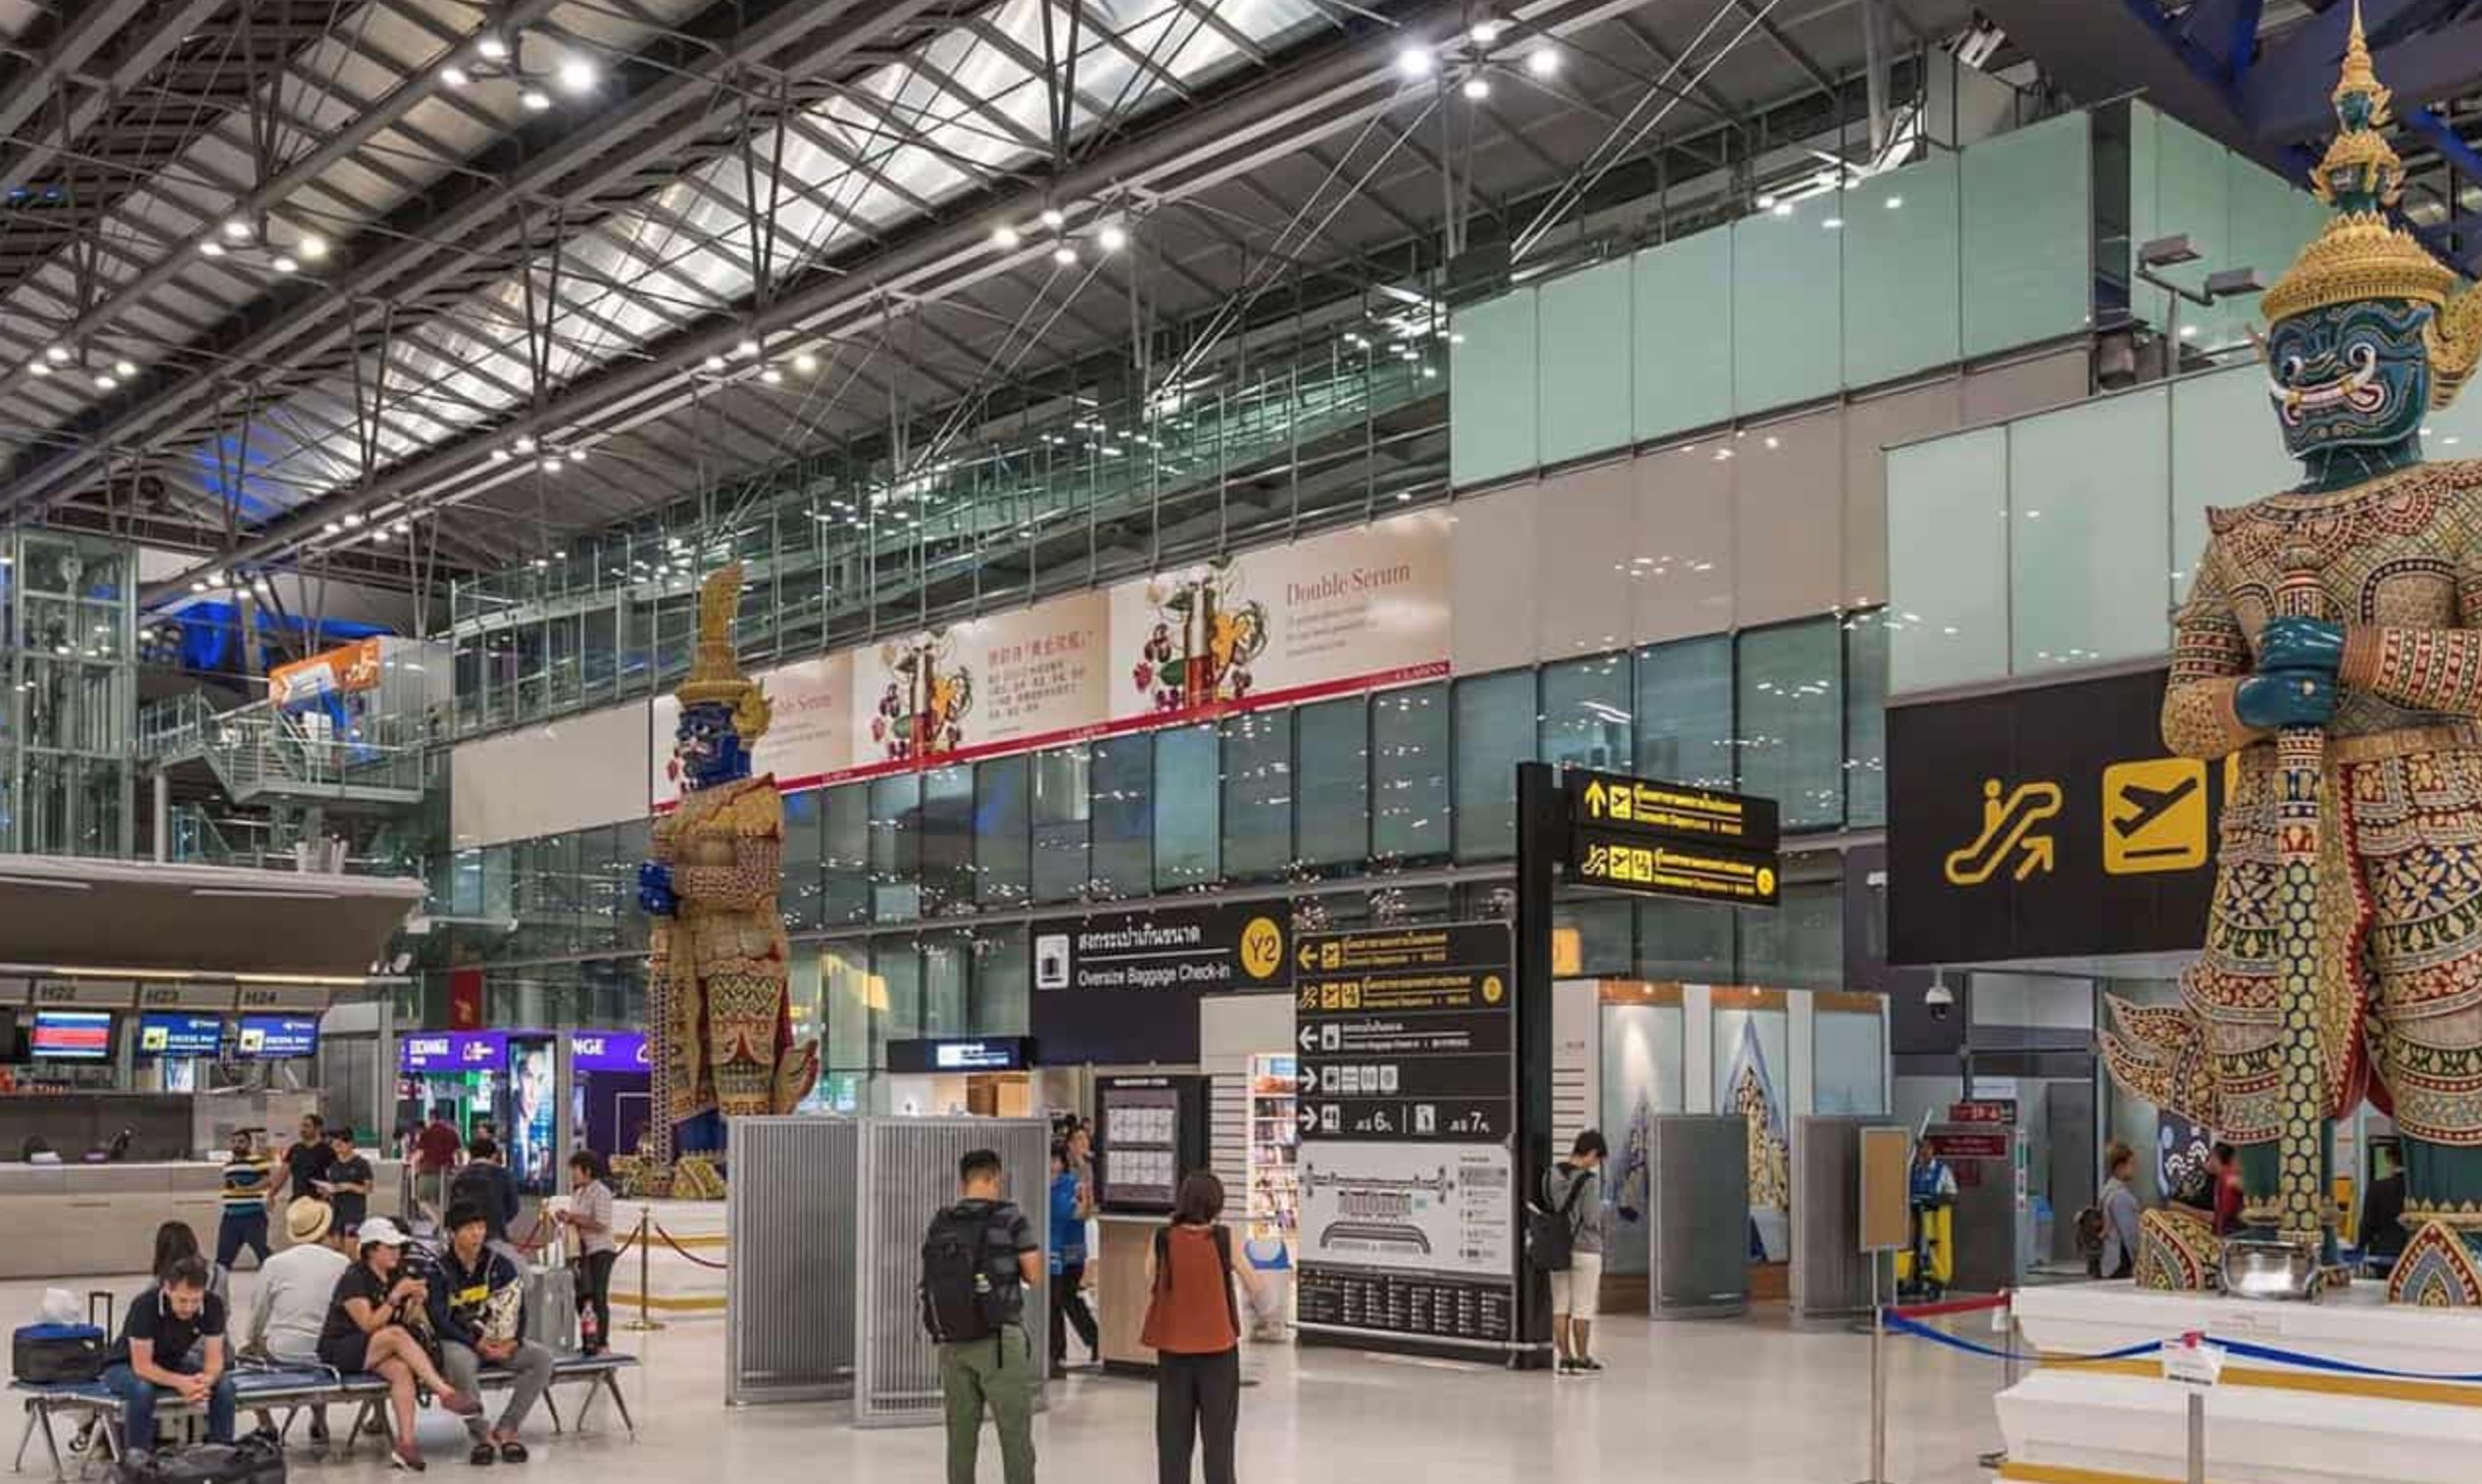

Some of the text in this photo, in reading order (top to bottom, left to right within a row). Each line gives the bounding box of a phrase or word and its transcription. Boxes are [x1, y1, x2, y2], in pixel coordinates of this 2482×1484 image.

[1287, 565, 1411, 606] Double Serum
[1249, 934, 1278, 963] Y2
[1078, 962, 1231, 988] Oversize Baggage Check-in
